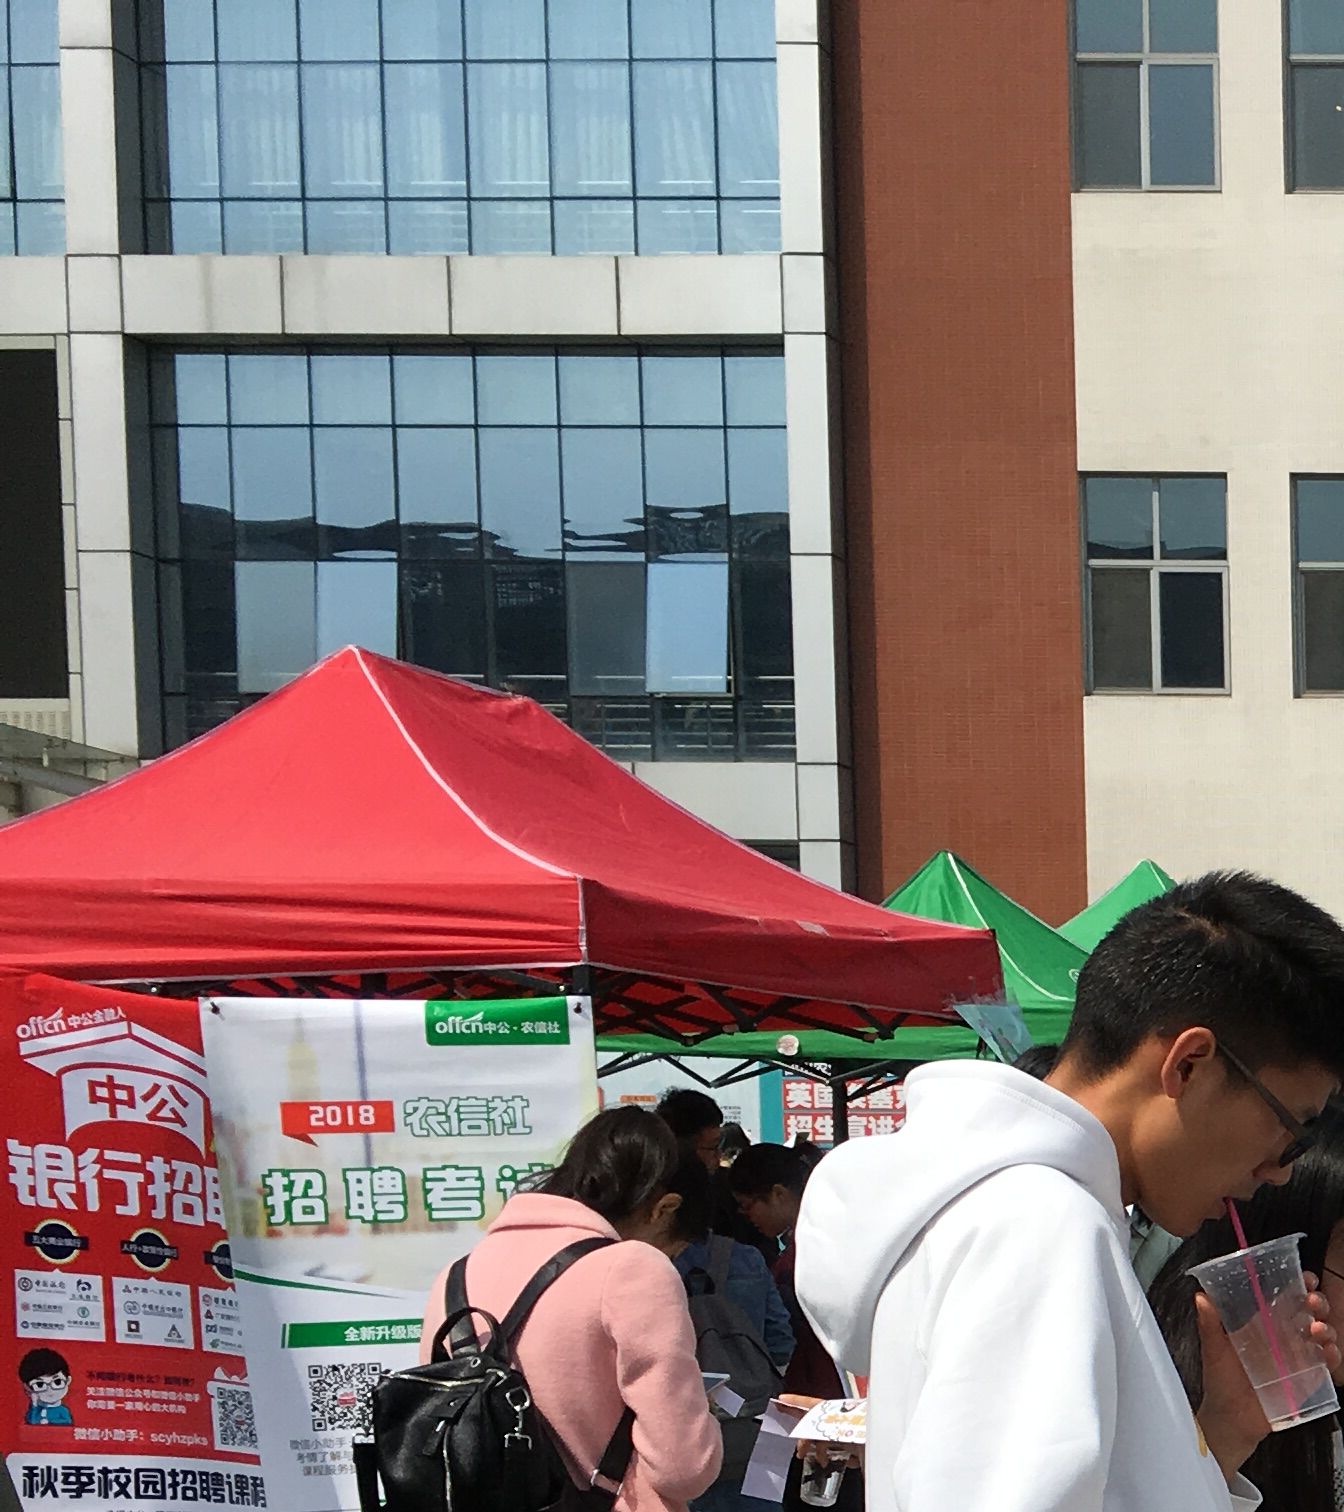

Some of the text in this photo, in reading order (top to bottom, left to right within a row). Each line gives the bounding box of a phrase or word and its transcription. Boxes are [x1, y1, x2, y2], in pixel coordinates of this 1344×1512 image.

[16, 1007, 67, 1039] offcn
[436, 1011, 484, 1034] offcn
[88, 1074, 189, 1128] 中公
[309, 1105, 375, 1126] 2018
[403, 1095, 532, 1138] 农信社
[344, 1323, 421, 1342] 全新升级版
